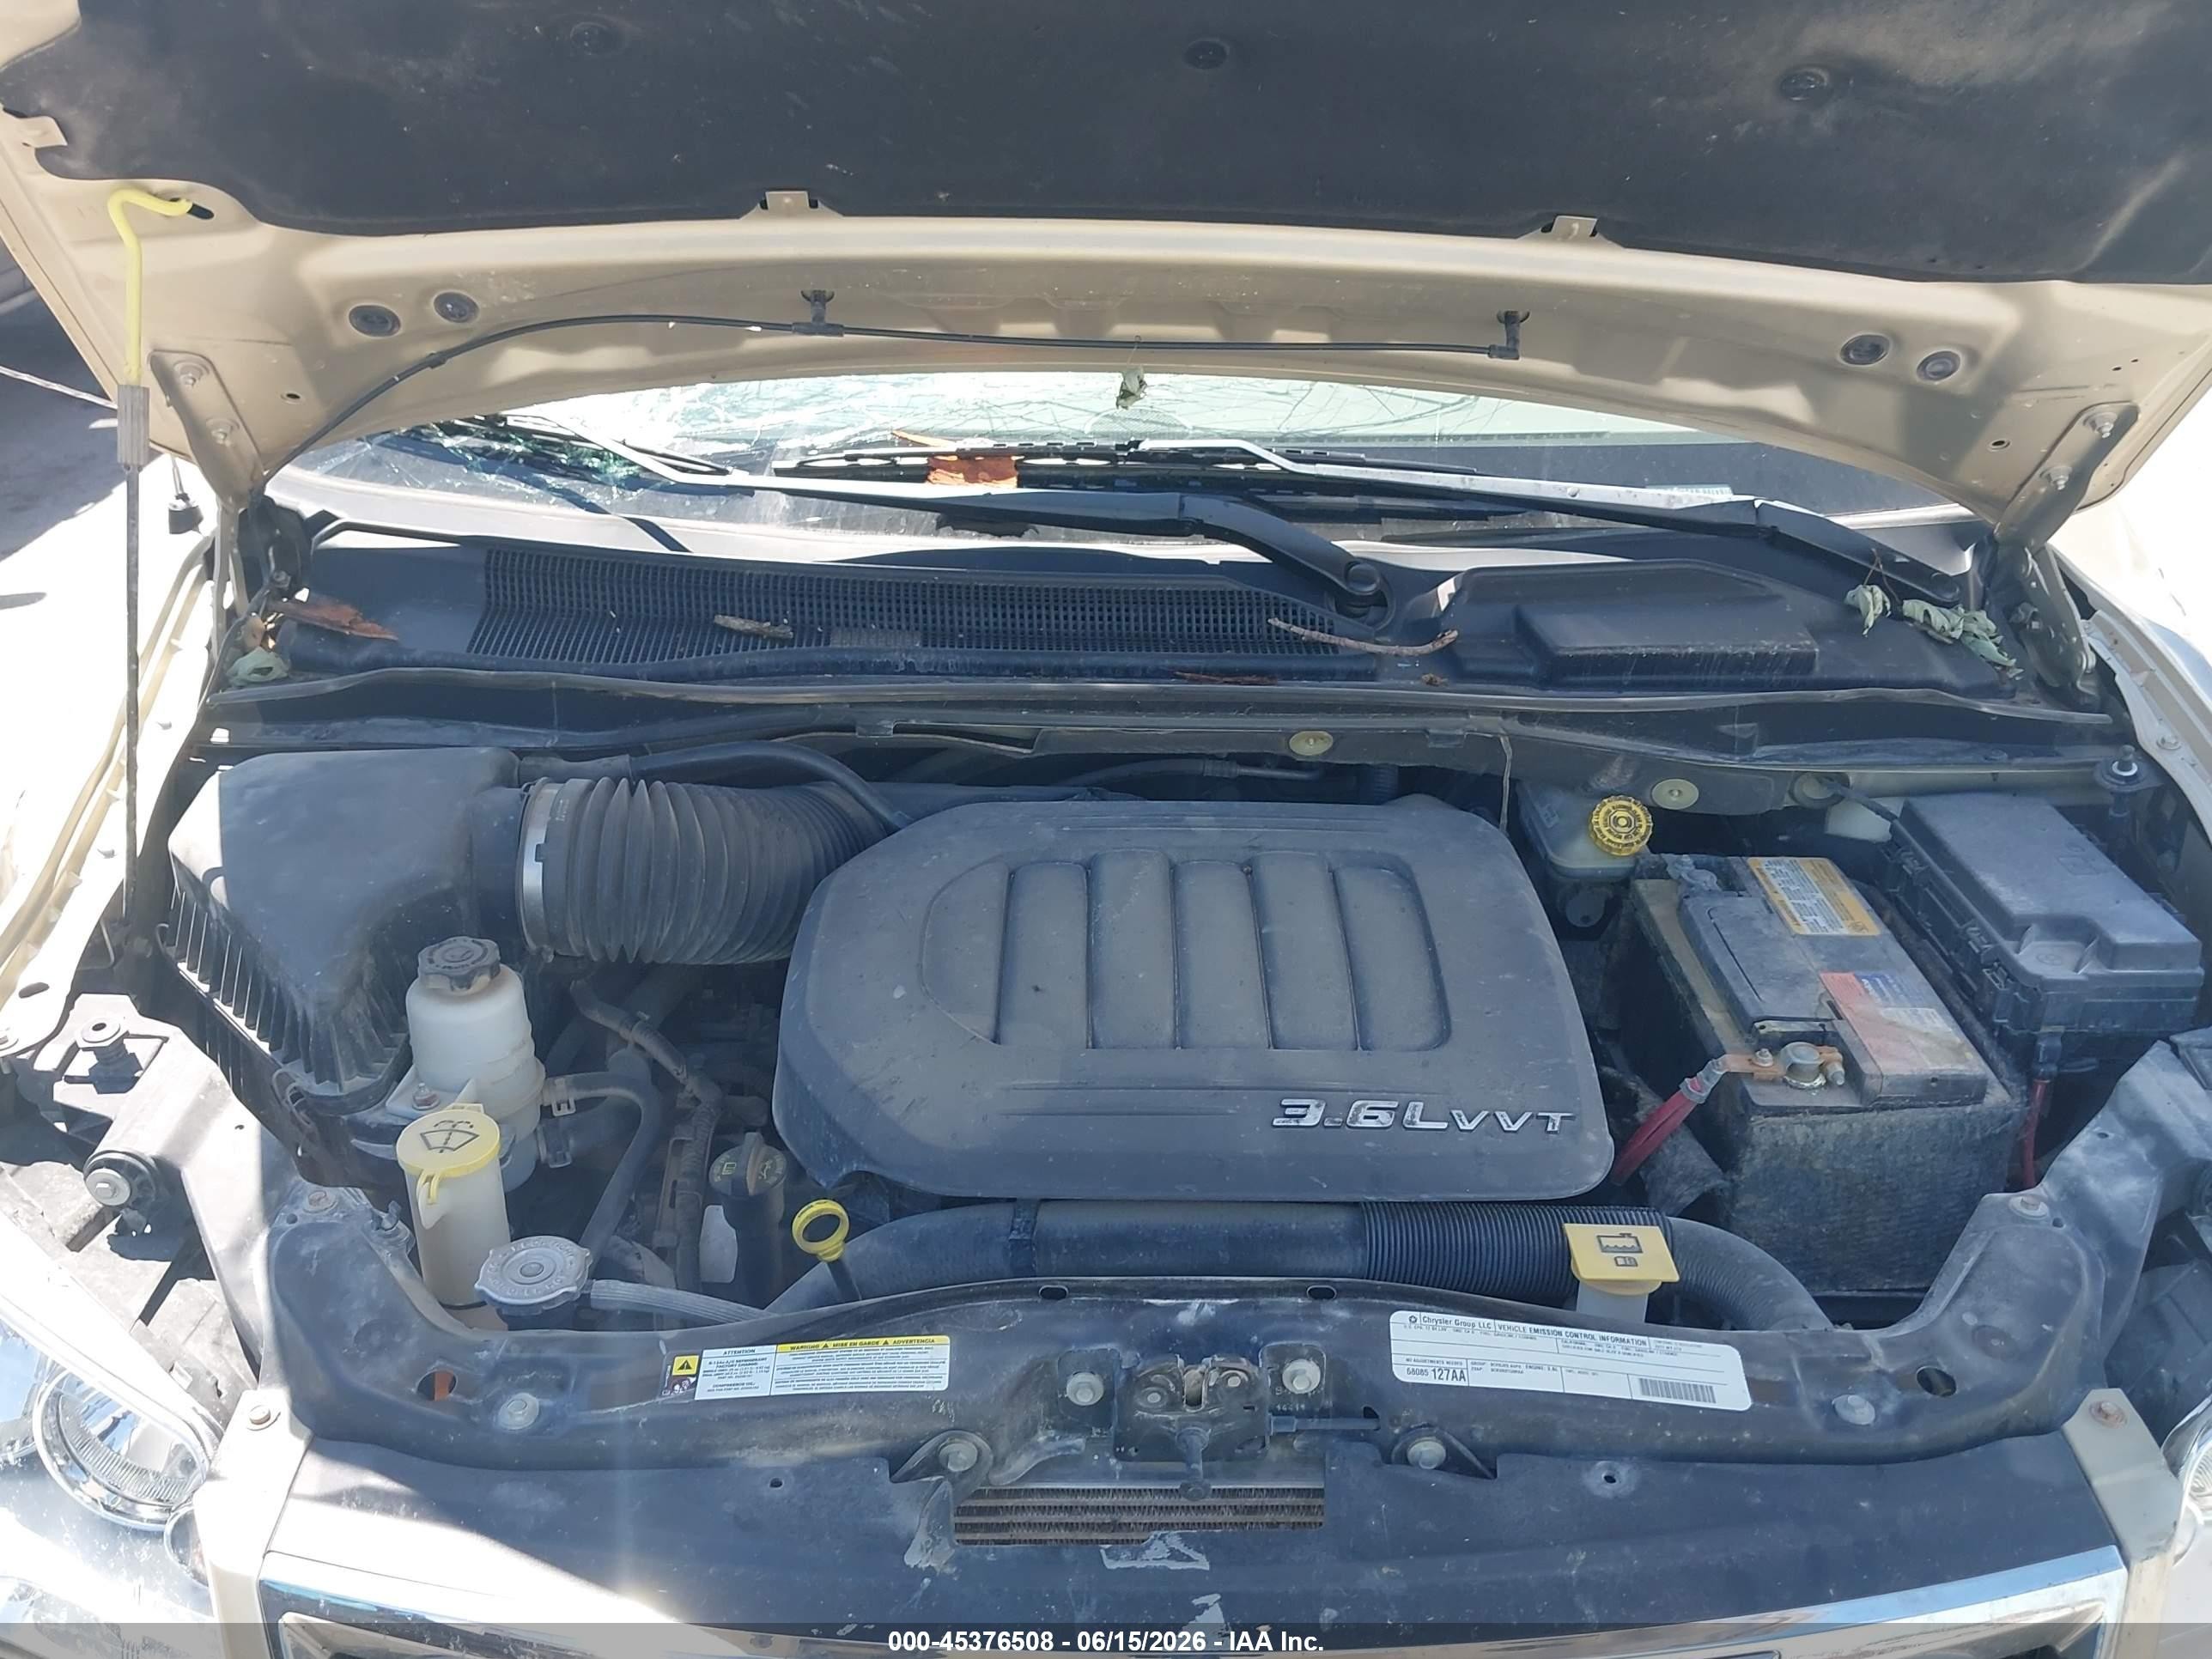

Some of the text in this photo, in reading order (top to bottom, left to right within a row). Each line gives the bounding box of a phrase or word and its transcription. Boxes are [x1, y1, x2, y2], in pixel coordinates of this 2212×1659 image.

[1422, 1316, 1492, 1329] Chrysler Group LLC
[1498, 1323, 1527, 1334] VEHICLE
[1528, 1327, 1563, 1337] EMISSION
[1565, 1331, 1596, 1341] CONTROL
[1599, 1334, 1647, 1346] INFORMATION
[1407, 1367, 1429, 1376] 68085
[1431, 1368, 1467, 1382] 127AA
